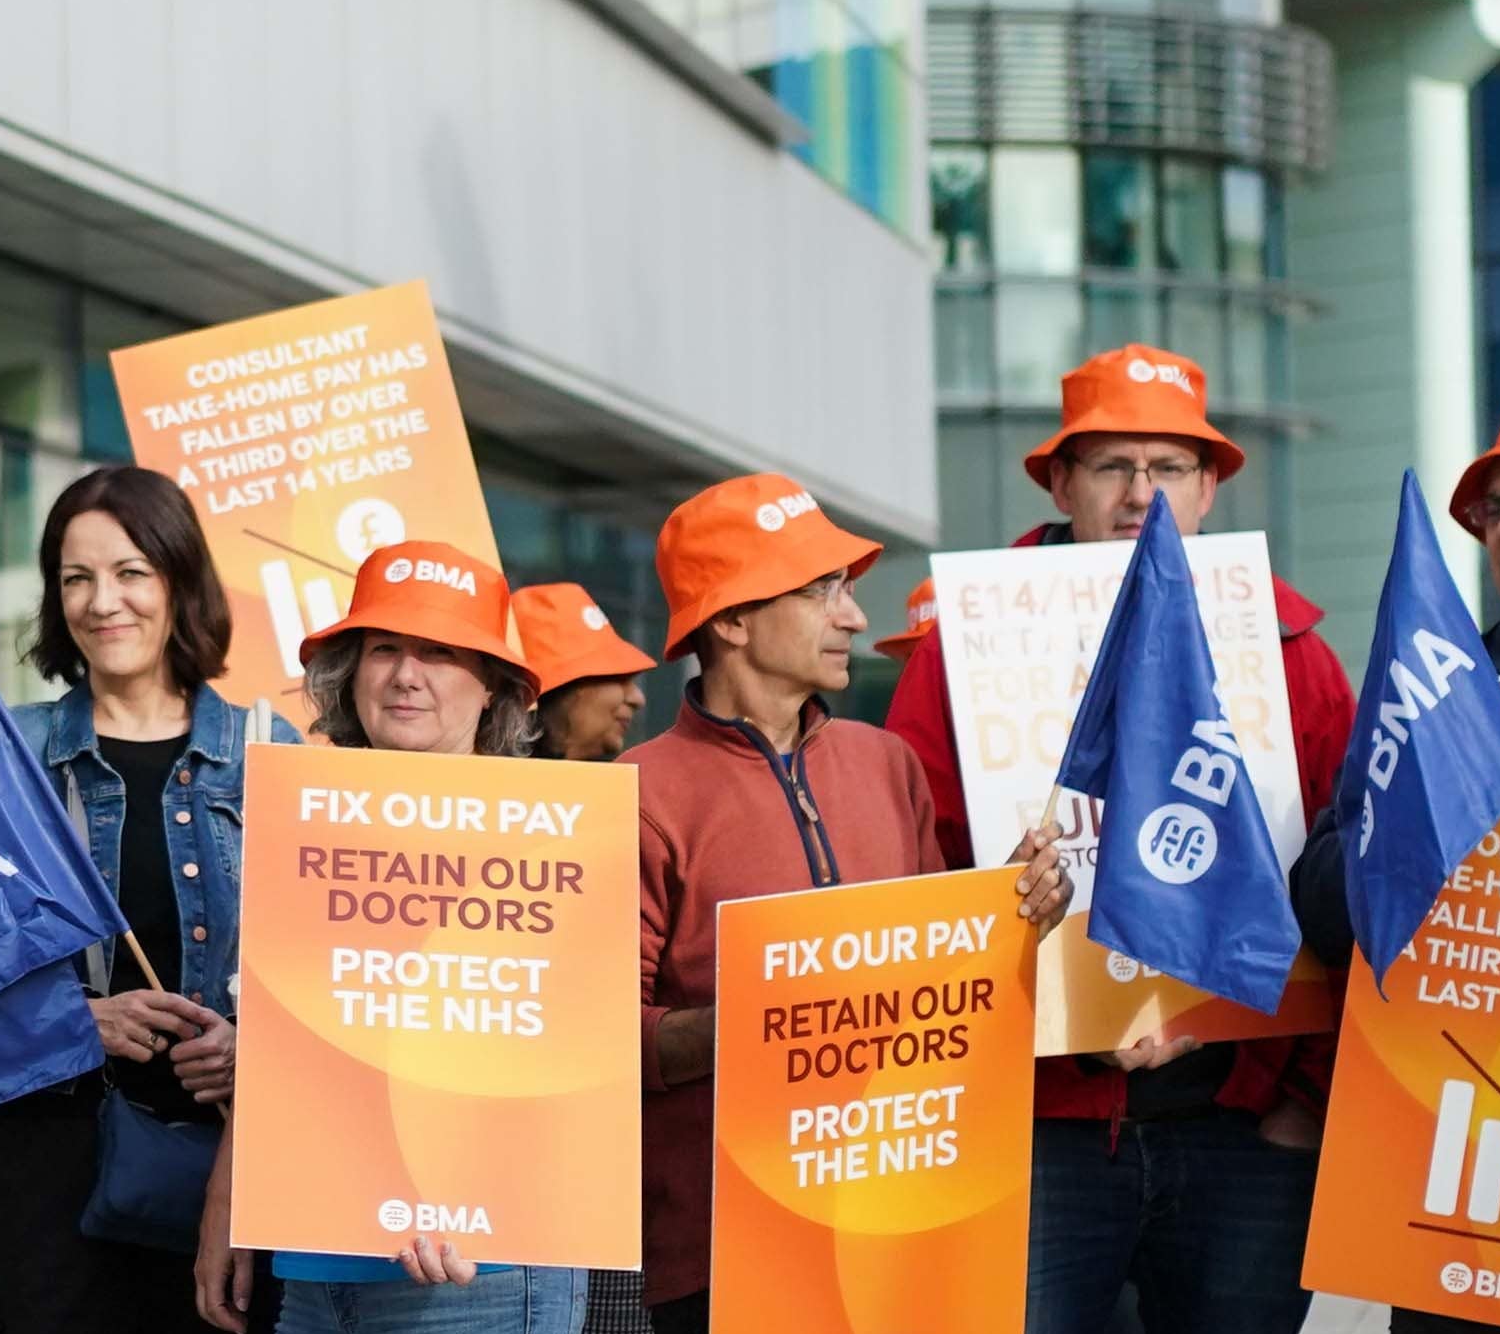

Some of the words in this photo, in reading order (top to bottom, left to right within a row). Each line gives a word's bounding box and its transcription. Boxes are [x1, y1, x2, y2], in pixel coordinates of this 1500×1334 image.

[144, 371, 312, 430] TAKE-HOME
[312, 358, 362, 391] PAY
[366, 343, 428, 378] HAS
[186, 324, 368, 389] CONSULTANT
[178, 465, 200, 488] A
[199, 443, 287, 482] THIRD
[289, 422, 368, 461] OVER
[368, 408, 429, 442] THE
[180, 410, 287, 455] FALLEN
[289, 399, 324, 429] BY
[329, 381, 408, 419] OVER
[207, 476, 277, 514] LAST
[283, 468, 318, 495] 14
[318, 445, 413, 487] YEARS
[414, 559, 477, 596] BMA
[300, 787, 371, 825] FIX
[381, 792, 487, 832] OUR
[498, 799, 584, 837] PAY
[299, 845, 466, 888] RETAIN
[480, 857, 584, 895] OUR
[327, 888, 554, 934] DOCTORS
[331, 947, 550, 994] PROTECT
[764, 937, 824, 980] FIX
[831, 925, 918, 971] OUR
[926, 914, 996, 958] PAY
[332, 989, 431, 1031] THE
[442, 996, 544, 1037] NHS
[763, 990, 900, 1043] RETAIN
[911, 978, 994, 1021] OUR
[787, 1024, 969, 1084] DOCTORS
[789, 1085, 965, 1146] PROTECT
[790, 1142, 869, 1188] THE
[878, 1129, 958, 1175] NHS
[415, 1203, 492, 1235] BMA
